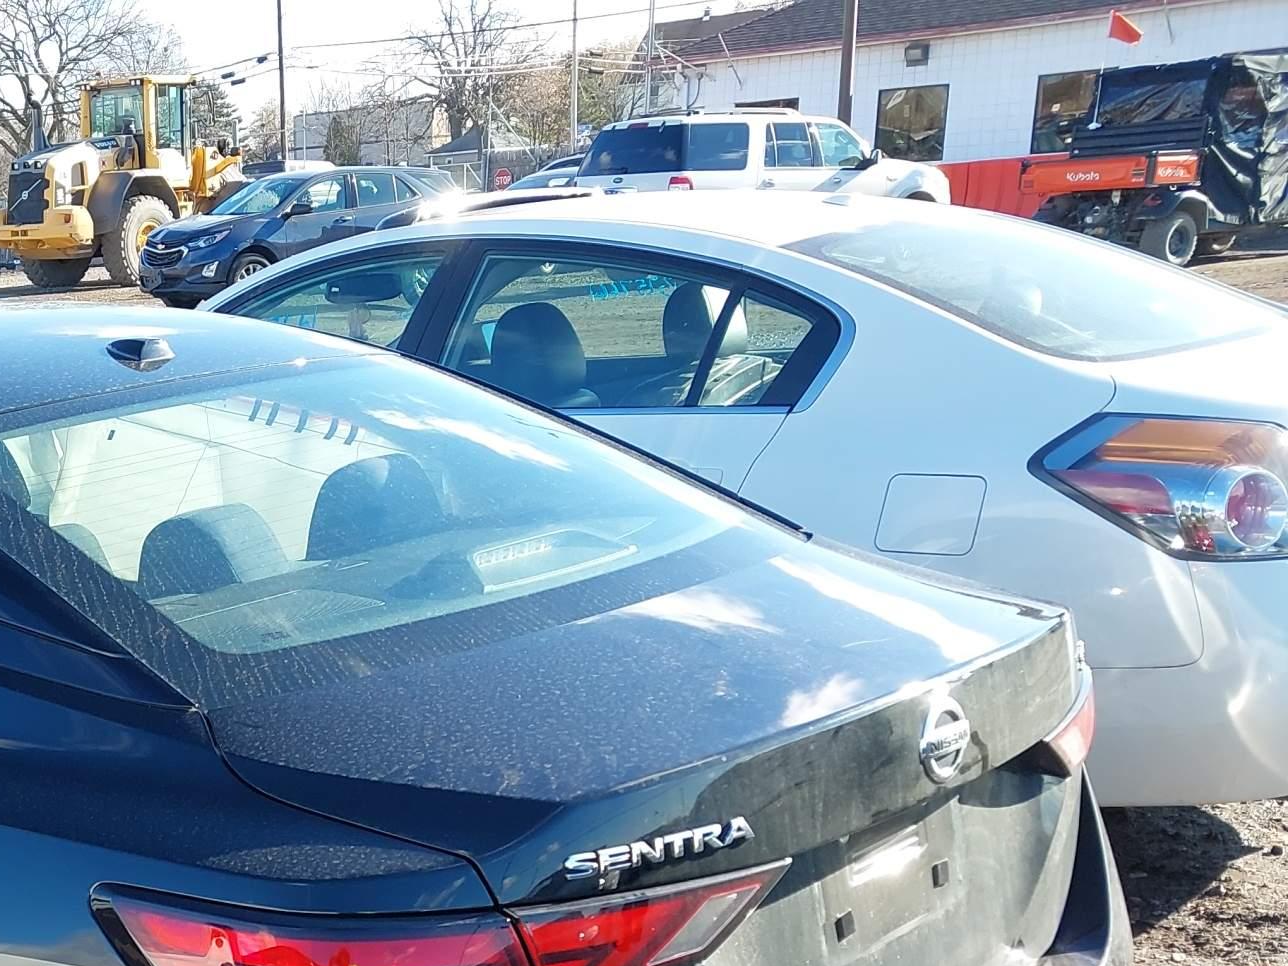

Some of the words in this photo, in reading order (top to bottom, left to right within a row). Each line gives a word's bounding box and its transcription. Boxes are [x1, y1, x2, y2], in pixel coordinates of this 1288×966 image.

[495, 175, 511, 186] STOP
[1066, 171, 1100, 181] Kubota
[929, 729, 969, 752] NISSAN
[563, 815, 756, 880] SENTRA
